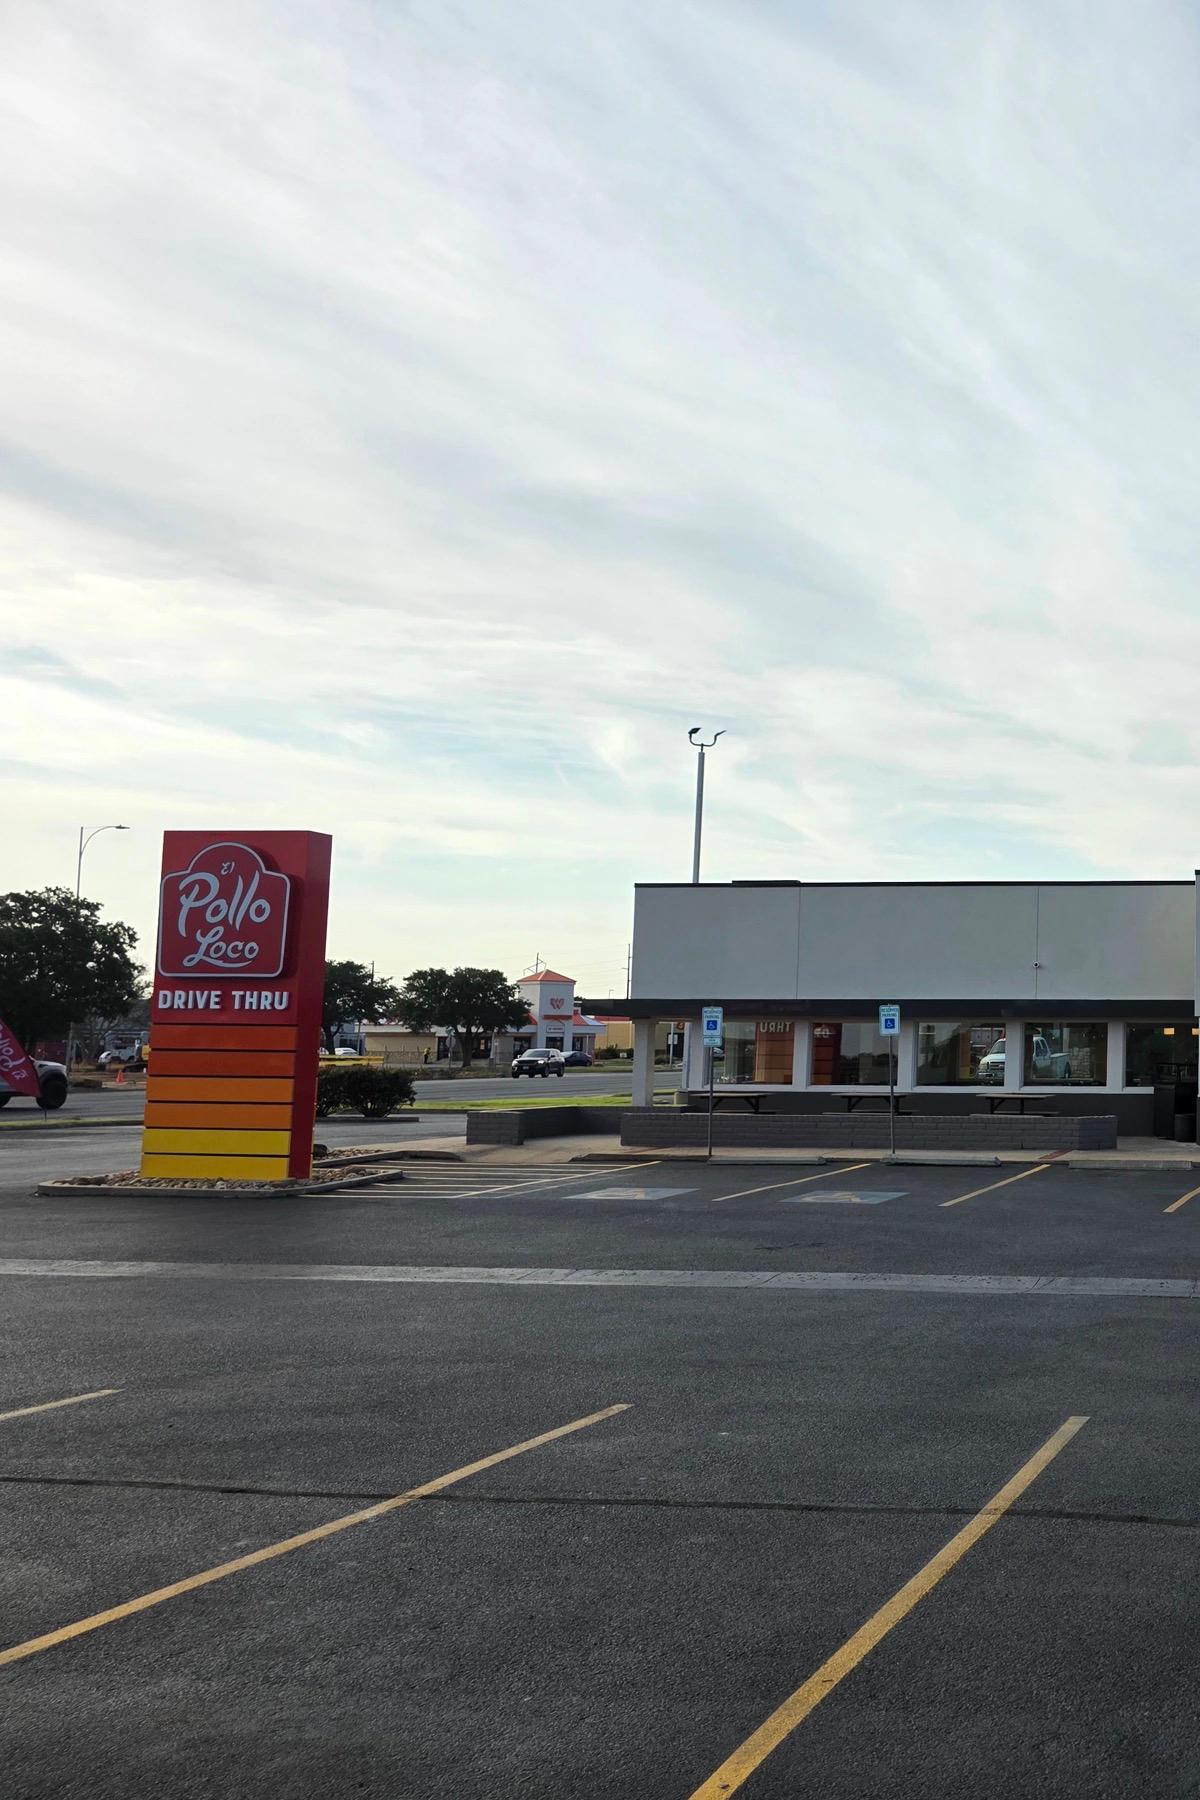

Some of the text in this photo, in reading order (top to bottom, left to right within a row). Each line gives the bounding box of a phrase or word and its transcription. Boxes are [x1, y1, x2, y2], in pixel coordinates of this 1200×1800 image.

[220, 862, 235, 875] El
[178, 870, 271, 938] Pollo
[182, 926, 259, 968] Loco
[158, 990, 289, 1010] DRIVE THRU
